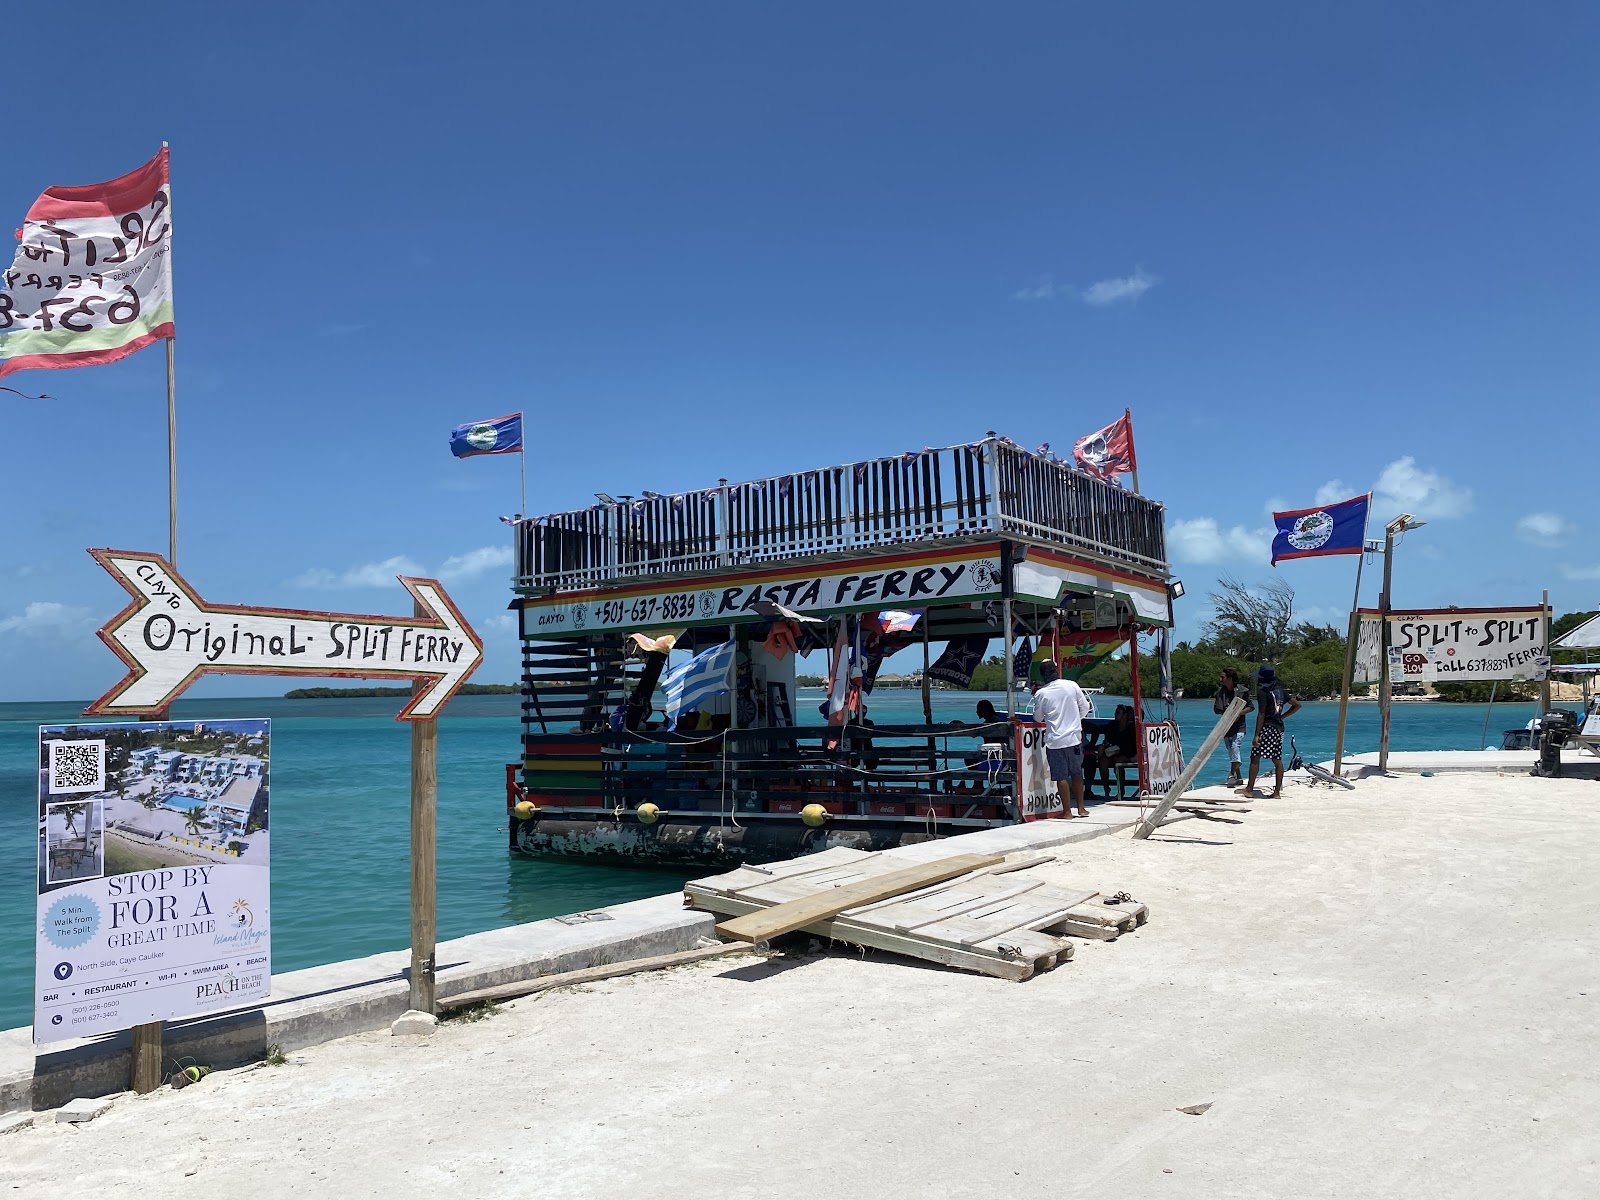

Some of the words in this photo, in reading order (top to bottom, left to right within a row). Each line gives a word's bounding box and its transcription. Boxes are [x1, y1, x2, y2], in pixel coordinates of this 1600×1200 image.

[136, 564, 182, 610] CLAYTO
[538, 613, 566, 626] CLAYTO
[594, 592, 695, 625] +501-637-8839
[718, 578, 821, 615] RASTA
[834, 564, 966, 605] FERRY
[1400, 620, 1463, 649] SPLIT
[1464, 625, 1479, 636] to
[1478, 617, 1540, 646] SPLIT
[400, 628, 464, 663] FERRY
[1405, 654, 1421, 662] GO
[1507, 646, 1545, 668] FERRY
[928, 667, 971, 684] COWBOYS
[1023, 727, 1047, 750] OPE
[1027, 792, 1061, 812] HOURS
[108, 870, 174, 897] STOP
[182, 866, 215, 888] BY
[68, 906, 84, 915] Min.
[108, 895, 180, 930] FOR
[190, 890, 215, 918] A
[54, 918, 73, 926] Walk
[74, 916, 93, 924] from
[56, 928, 71, 937] The
[73, 926, 90, 935] Split
[107, 926, 166, 948] GREAT
[172, 919, 216, 939] TIME
[212, 932, 240, 945] Island
[240, 928, 268, 944] Magic
[76, 962, 98, 972] North
[99, 960, 118, 968] Side,
[119, 956, 137, 966] Caye
[138, 951, 165, 963] Caulker
[43, 994, 59, 1002] BAR
[84, 980, 138, 996] RESTAURANT
[158, 972, 177, 982] WI-FI
[192, 966, 211, 976] SWIM
[211, 963, 230, 973] AREA
[246, 956, 267, 966] BEACH
[196, 979, 240, 998] PEACH
[251, 974, 263, 982] THE
[241, 981, 261, 990] BEACH
[71, 1006, 88, 1015] (501)
[71, 1016, 87, 1025] (501)
